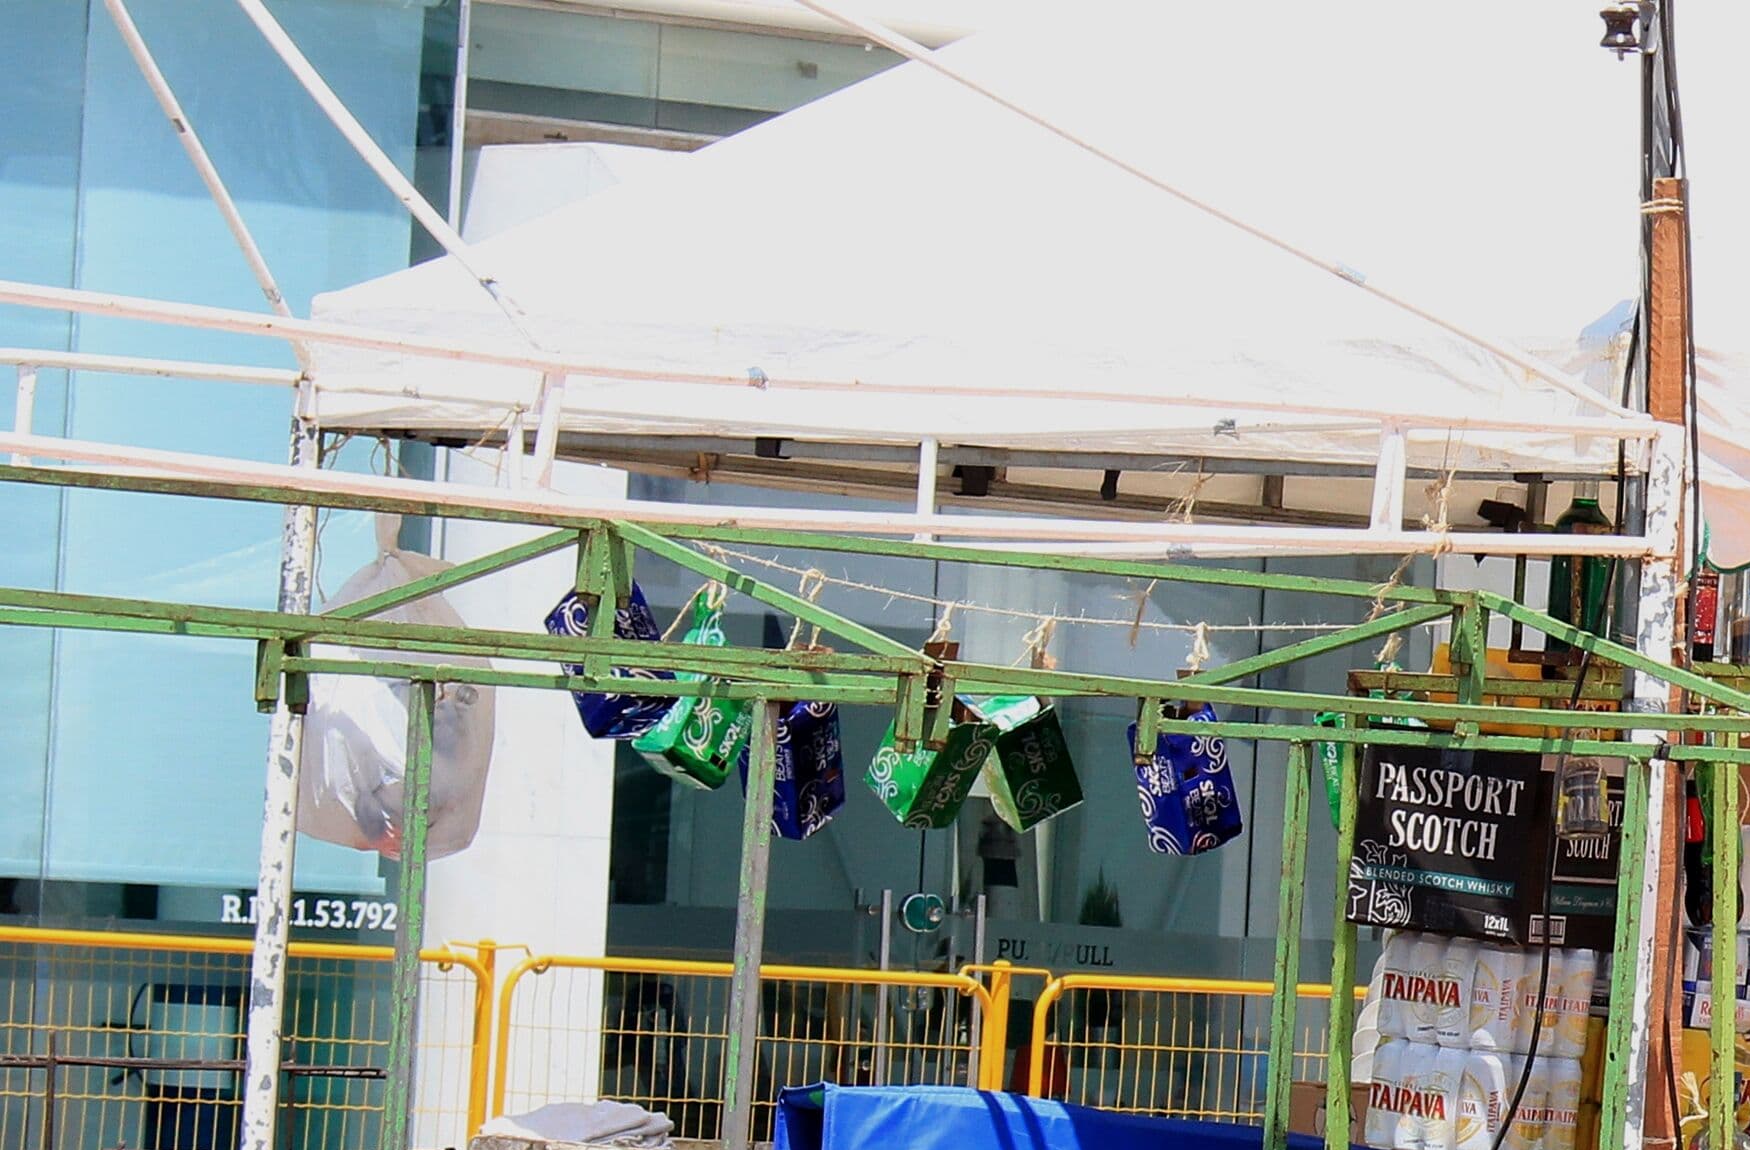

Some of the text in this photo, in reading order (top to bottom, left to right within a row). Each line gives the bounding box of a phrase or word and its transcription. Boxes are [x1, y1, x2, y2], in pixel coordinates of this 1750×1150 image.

[1376, 762, 1525, 817] PASSPORT
[1388, 810, 1499, 860] SCOTCH
[1365, 867, 1513, 897] BLENDED SCOTCH WHISKY
